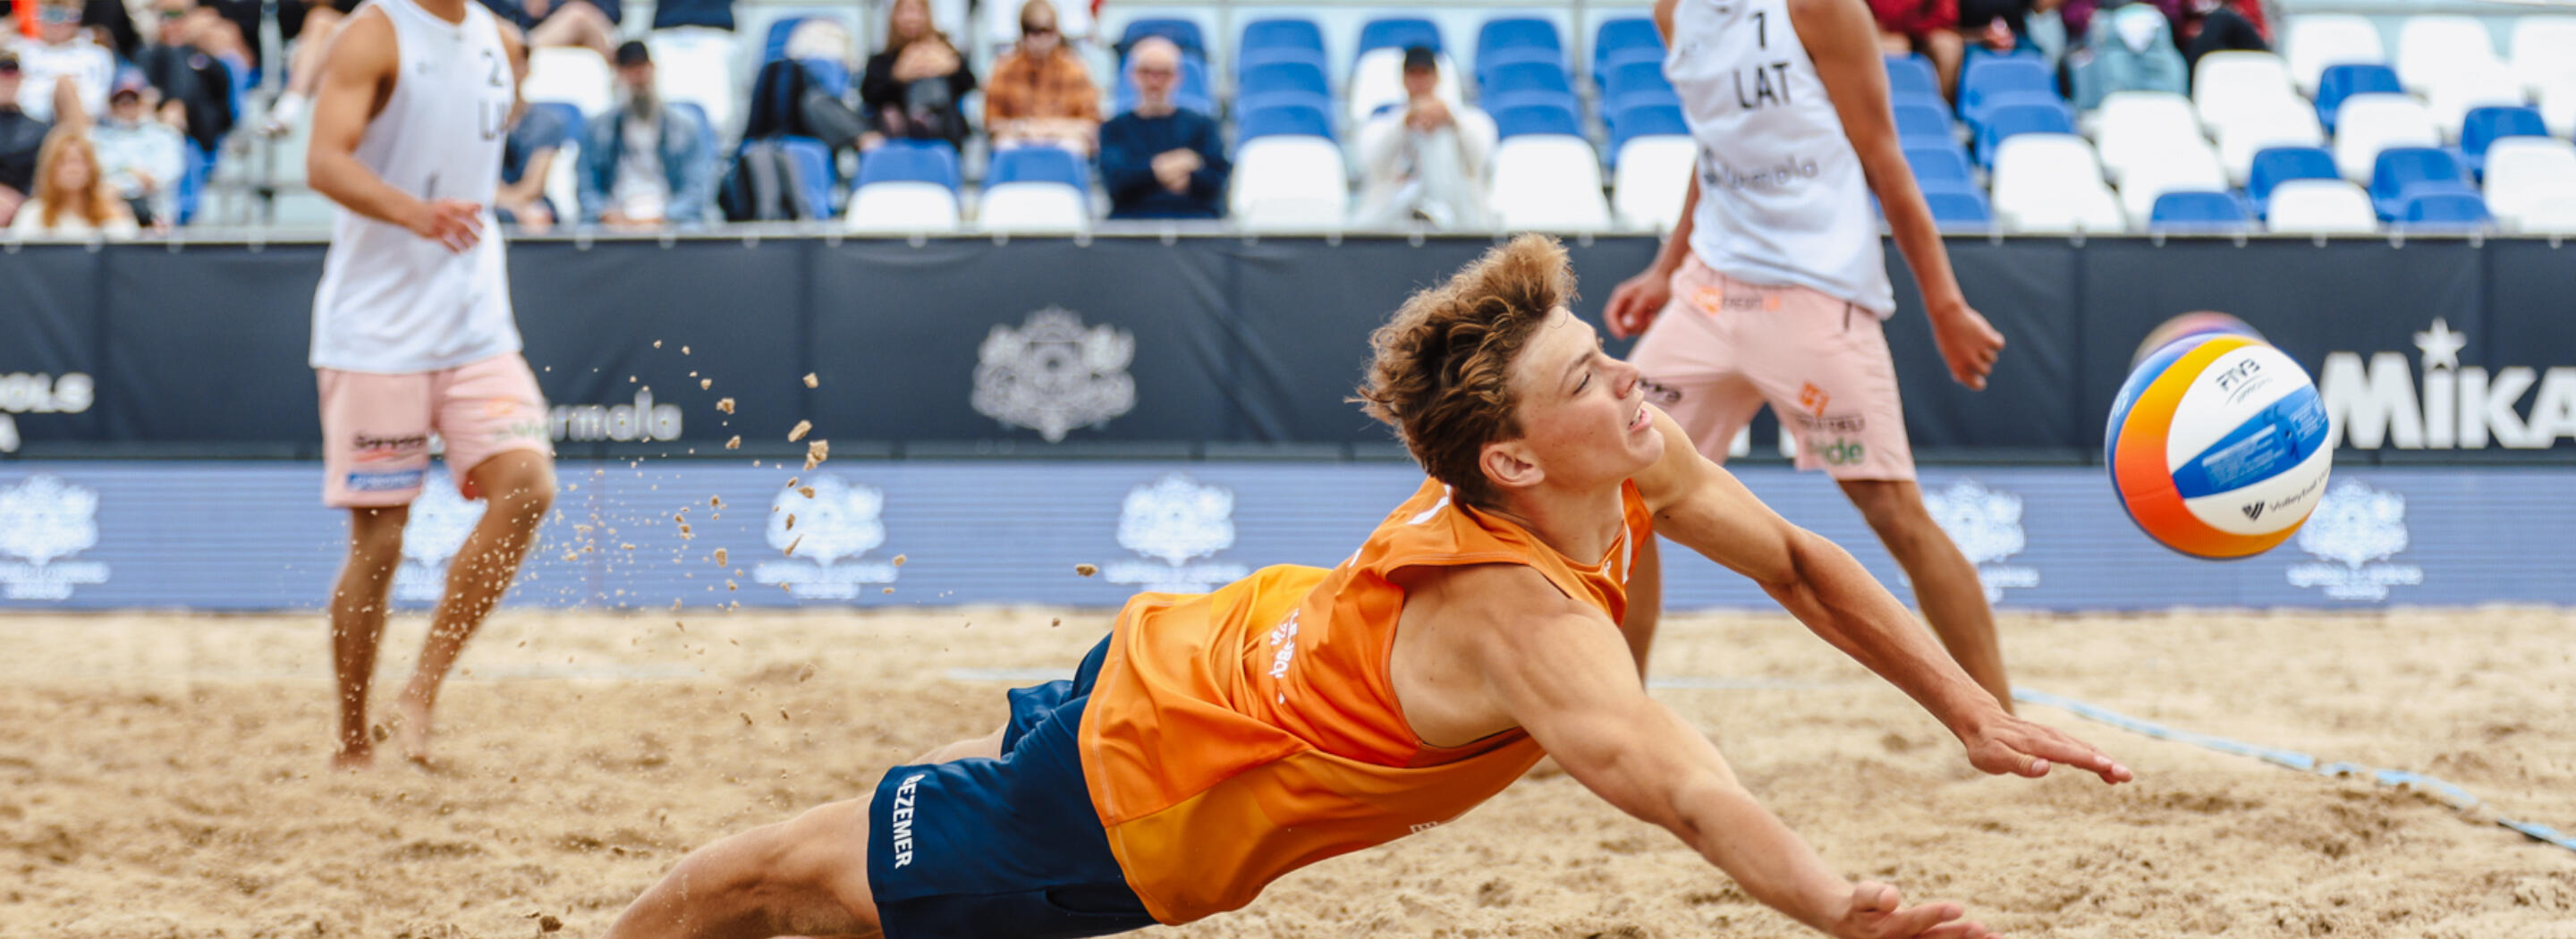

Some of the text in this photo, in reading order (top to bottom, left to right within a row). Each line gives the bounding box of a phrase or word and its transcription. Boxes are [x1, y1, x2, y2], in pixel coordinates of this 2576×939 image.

[1750, 11, 1767, 50] 1
[481, 48, 504, 87] 2
[1733, 61, 1792, 110] LAT
[0, 371, 96, 414] OLS
[549, 388, 683, 442] rmala
